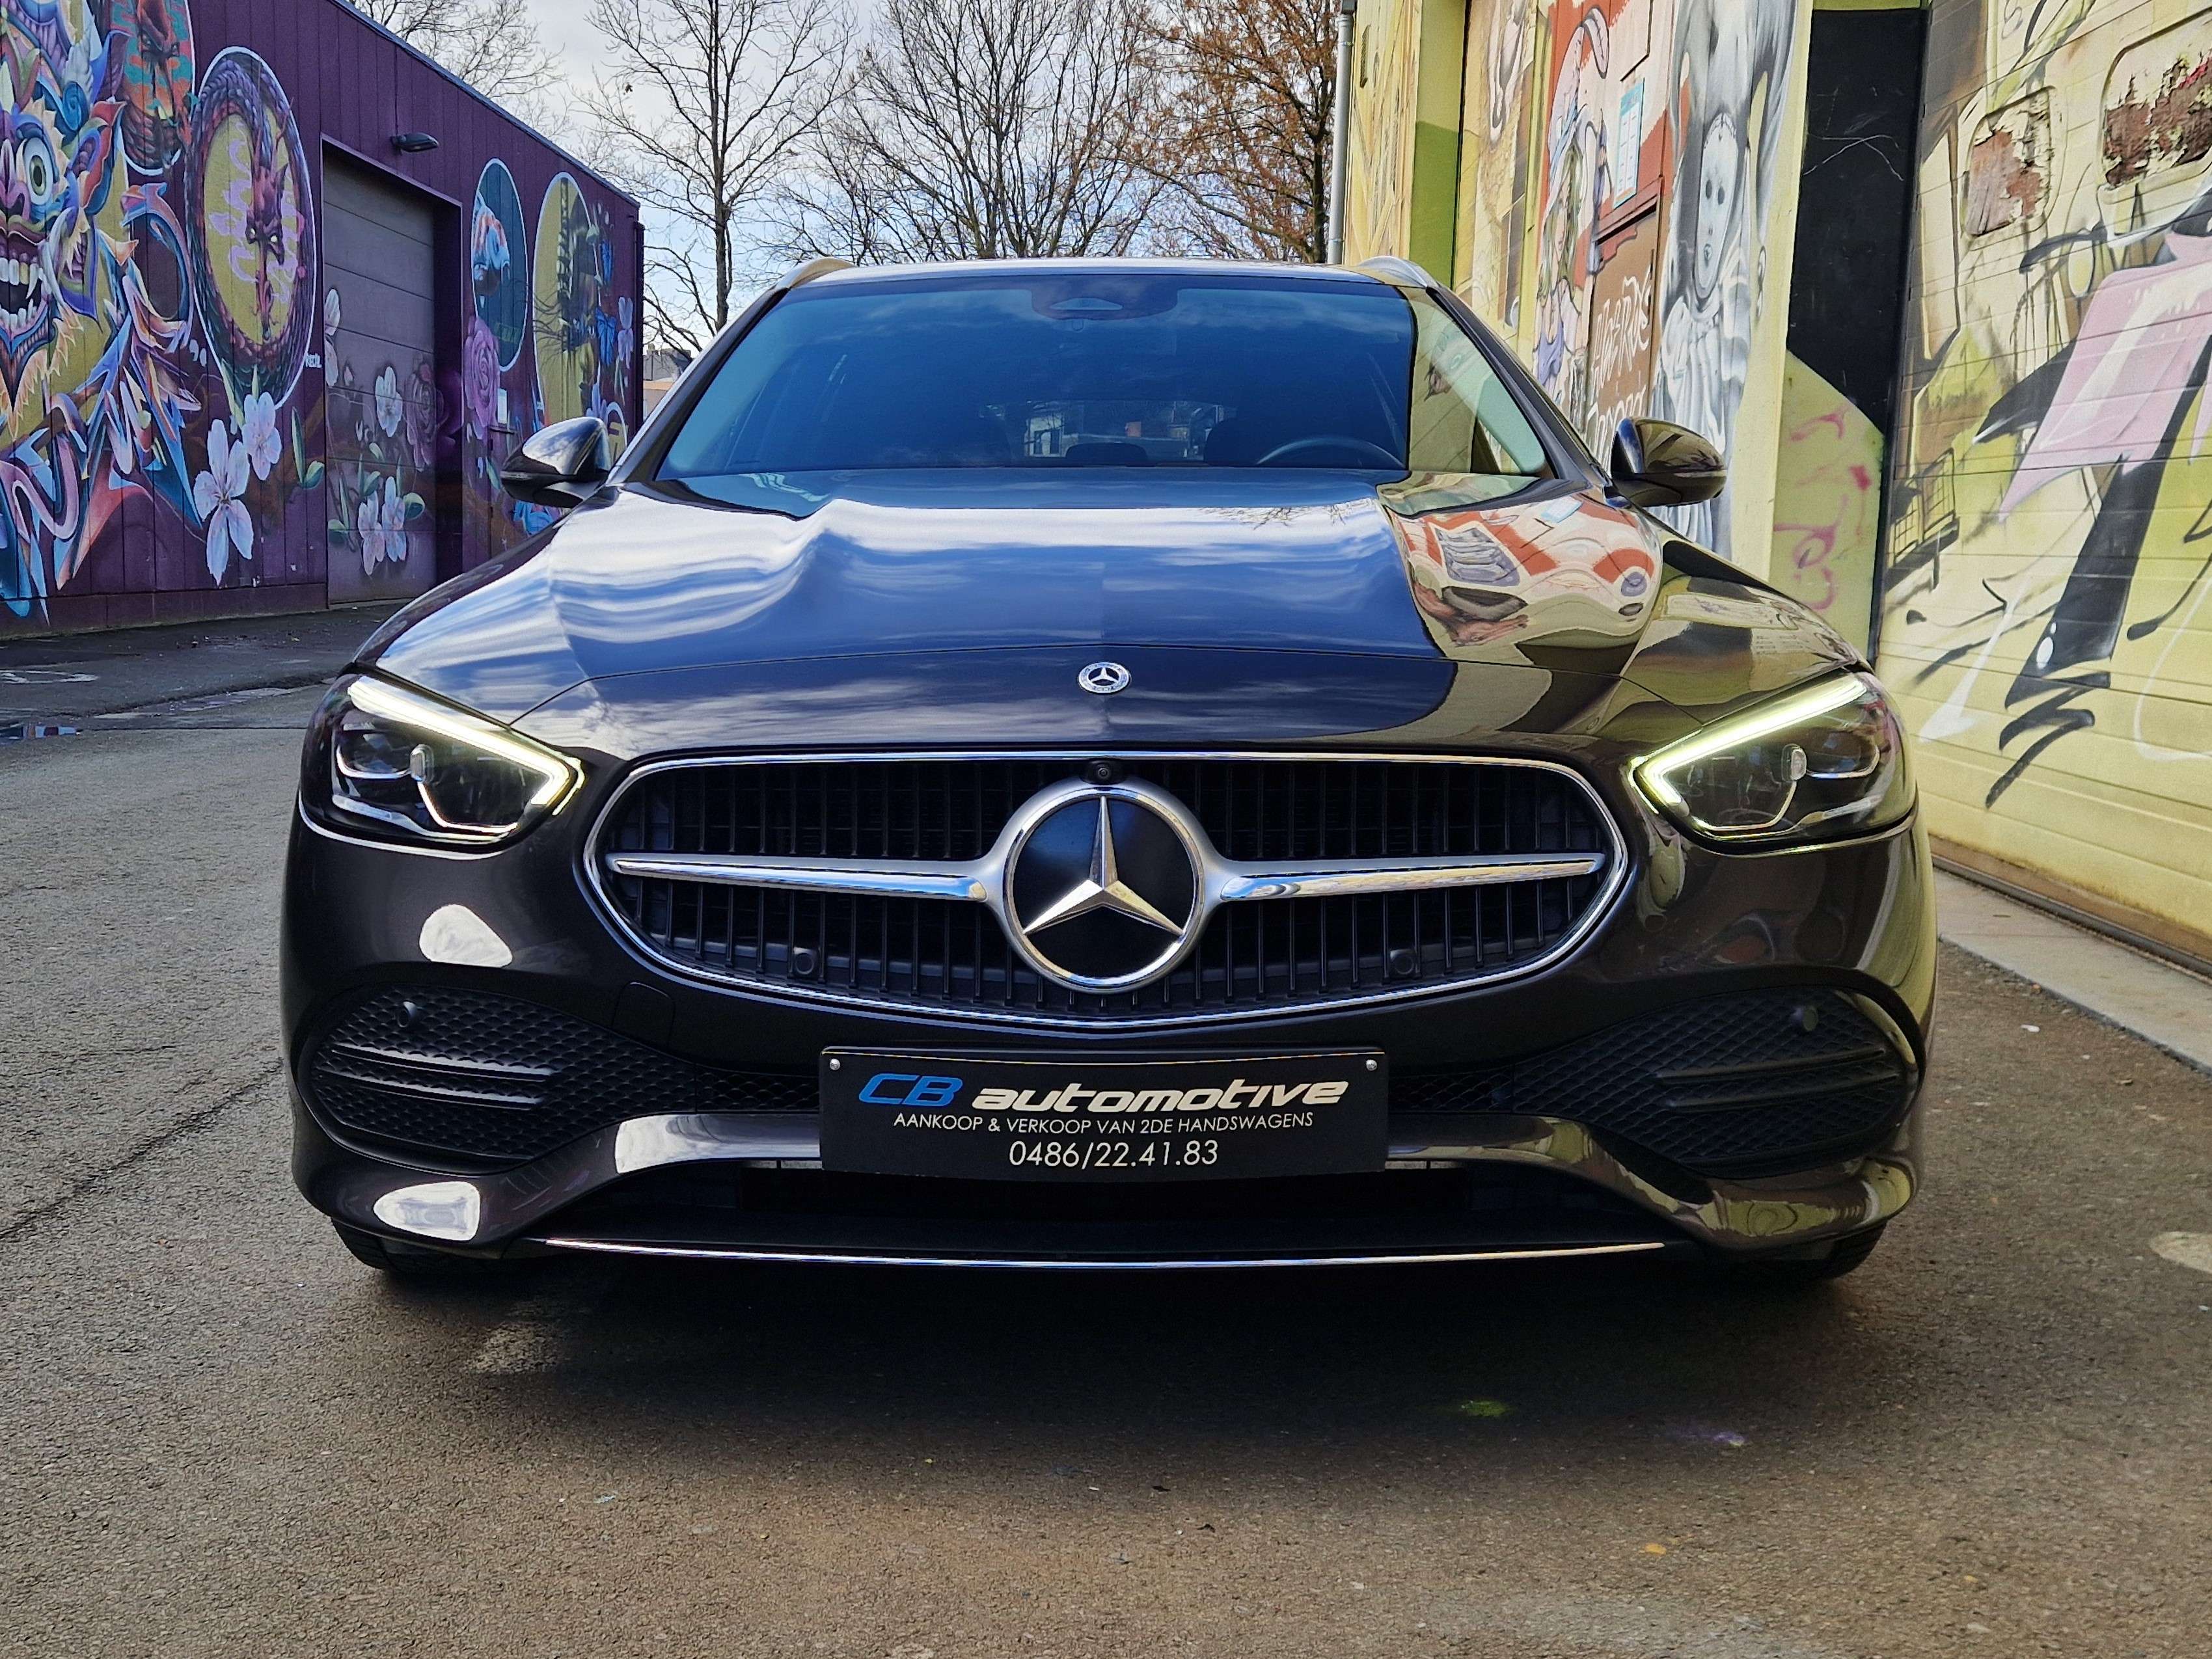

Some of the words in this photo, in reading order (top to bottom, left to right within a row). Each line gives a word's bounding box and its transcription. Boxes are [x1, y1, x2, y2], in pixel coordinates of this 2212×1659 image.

[858, 1073, 963, 1107] CB
[972, 1079, 1349, 1113] automotive
[893, 1113, 983, 1131] AANKOOP
[988, 1118, 1001, 1132] &
[1006, 1118, 1091, 1134] VERKOOP
[1097, 1120, 1136, 1134] VAN
[1140, 1118, 1173, 1134] 2DE
[1178, 1111, 1314, 1133] HANDSWAGENS
[1009, 1140, 1218, 1170] 0486/22.41.83
